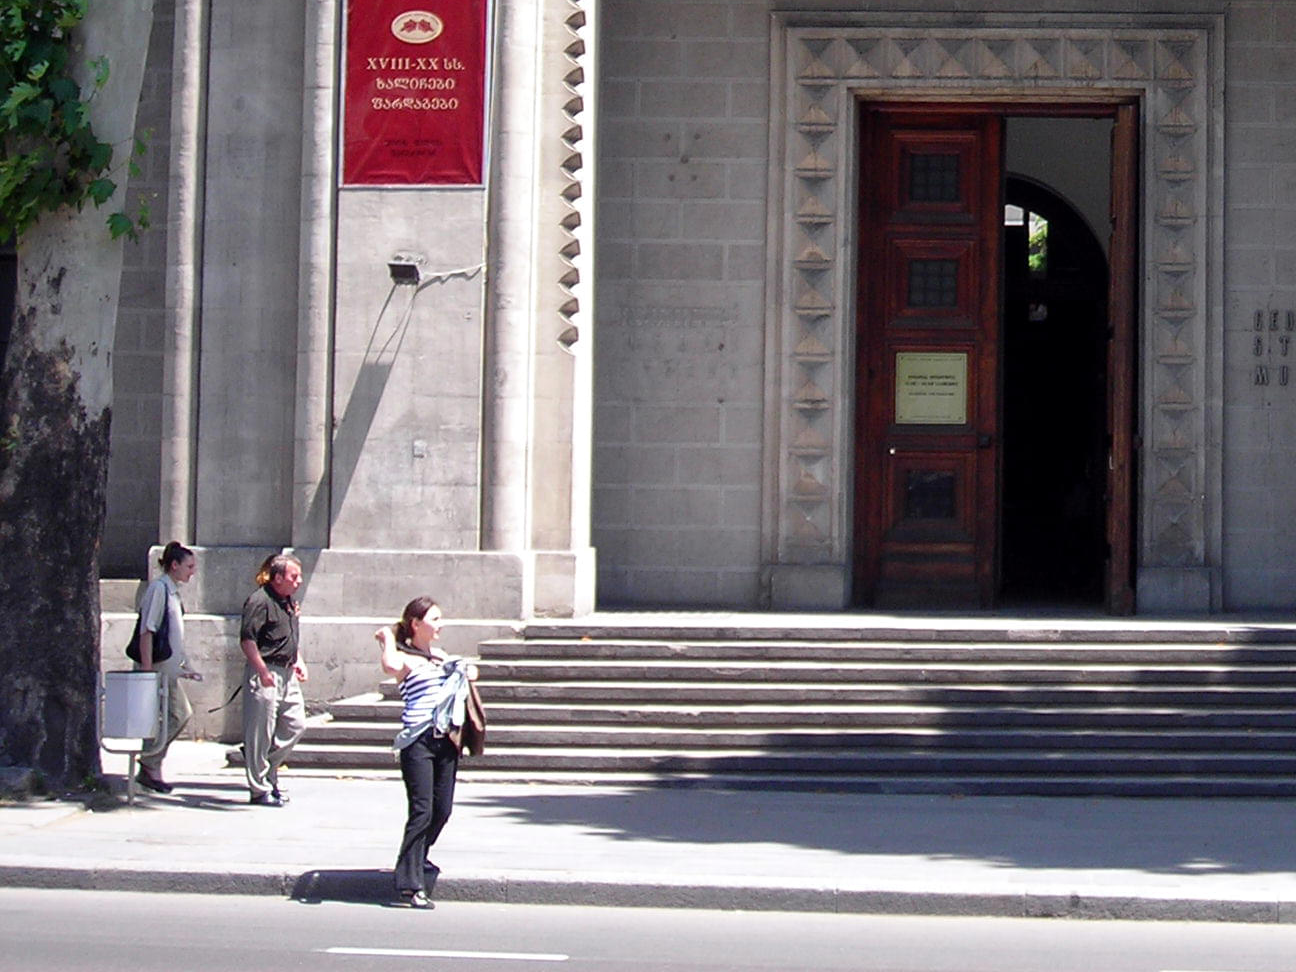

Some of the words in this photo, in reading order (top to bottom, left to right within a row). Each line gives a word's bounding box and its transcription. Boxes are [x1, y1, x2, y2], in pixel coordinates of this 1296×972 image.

[367, 57, 439, 70] XVIII-XX
[376, 78, 455, 90] ხალიჩები
[372, 98, 458, 110] ფარდაგები
